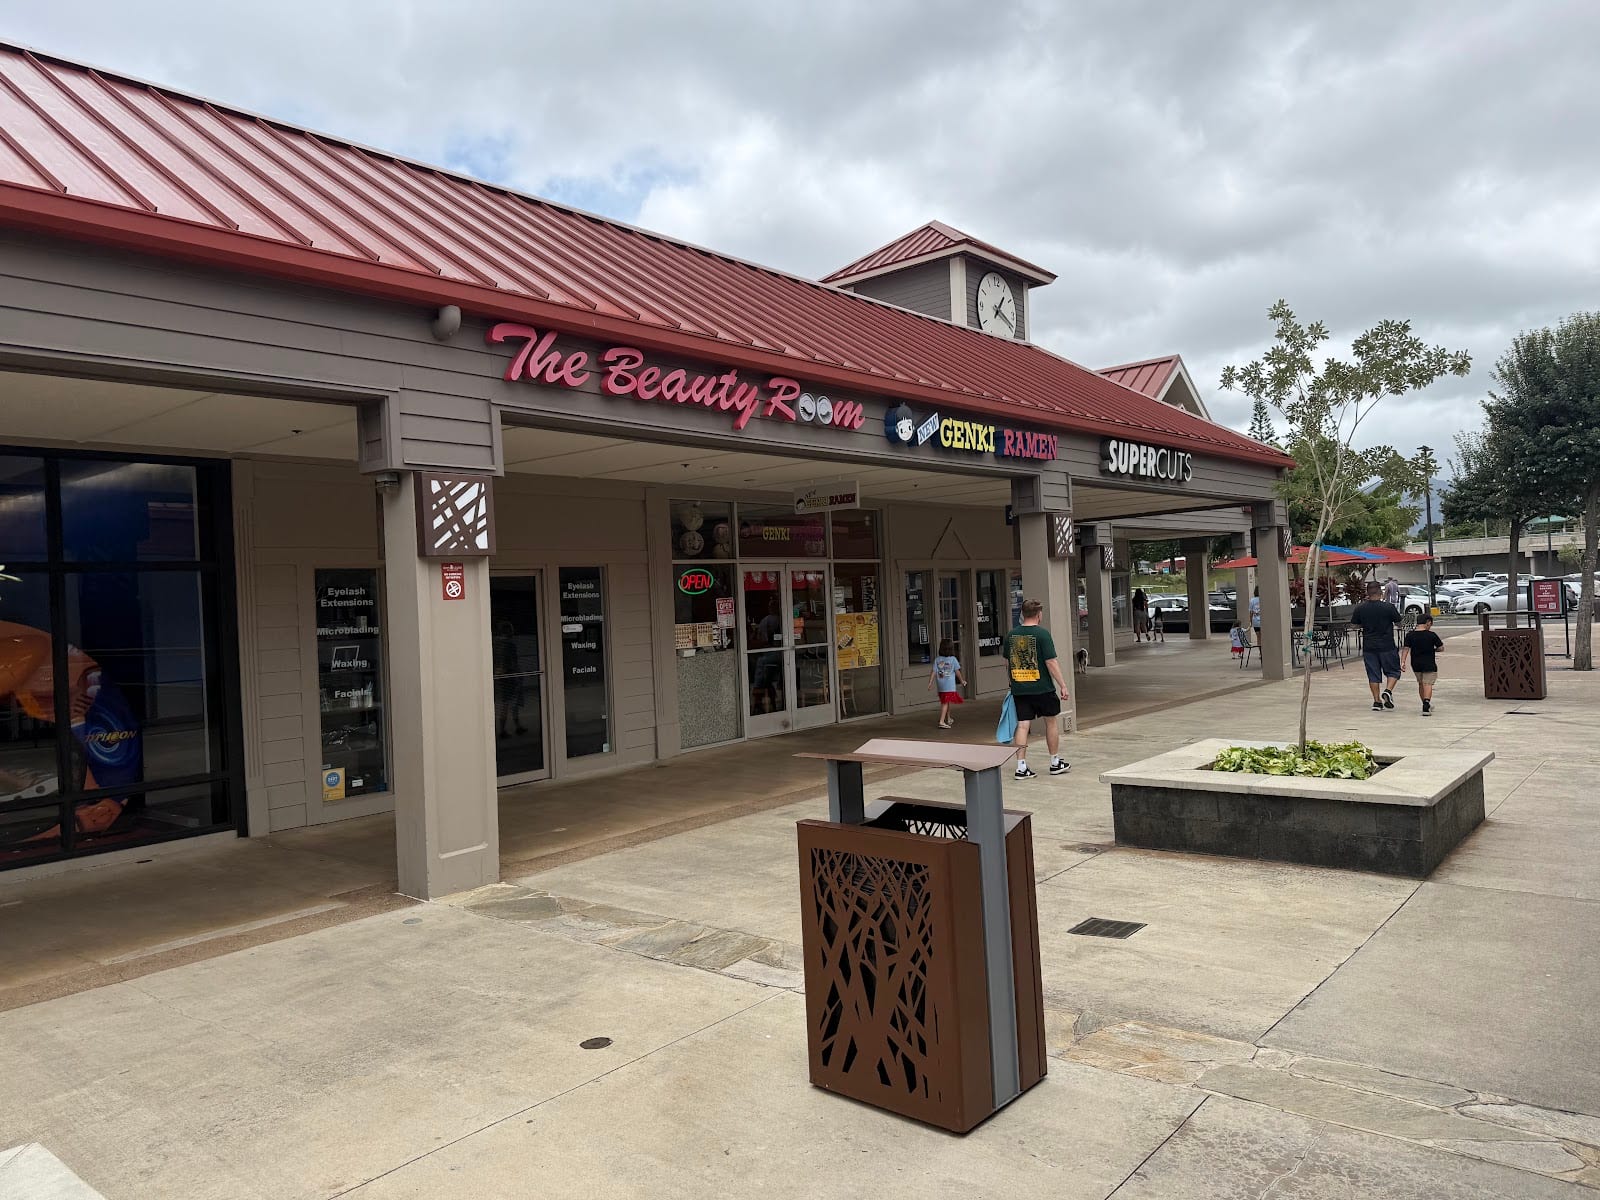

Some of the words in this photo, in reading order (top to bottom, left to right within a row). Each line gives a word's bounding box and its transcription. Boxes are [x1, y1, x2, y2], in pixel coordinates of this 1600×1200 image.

[993, 275, 1000, 288] 12
[488, 322, 590, 387] The
[599, 347, 759, 431] Beauty
[762, 376, 865, 430] Room
[917, 413, 939, 442] NEW
[940, 416, 996, 453] GENKI
[1003, 428, 1058, 460] RAMEN
[1106, 439, 1193, 482] SUPERCUTS
[762, 527, 790, 541] GENKI
[567, 582, 595, 591] Eyelash
[680, 574, 711, 590] OPEN
[327, 587, 366, 597] Eyelash
[562, 591, 600, 600] Extensions
[320, 598, 375, 608] Extensions
[560, 614, 605, 623] Microblading
[316, 625, 380, 636] Microblading
[570, 641, 597, 650] Waxing
[331, 659, 369, 669] Waxing
[572, 666, 597, 675] Facials
